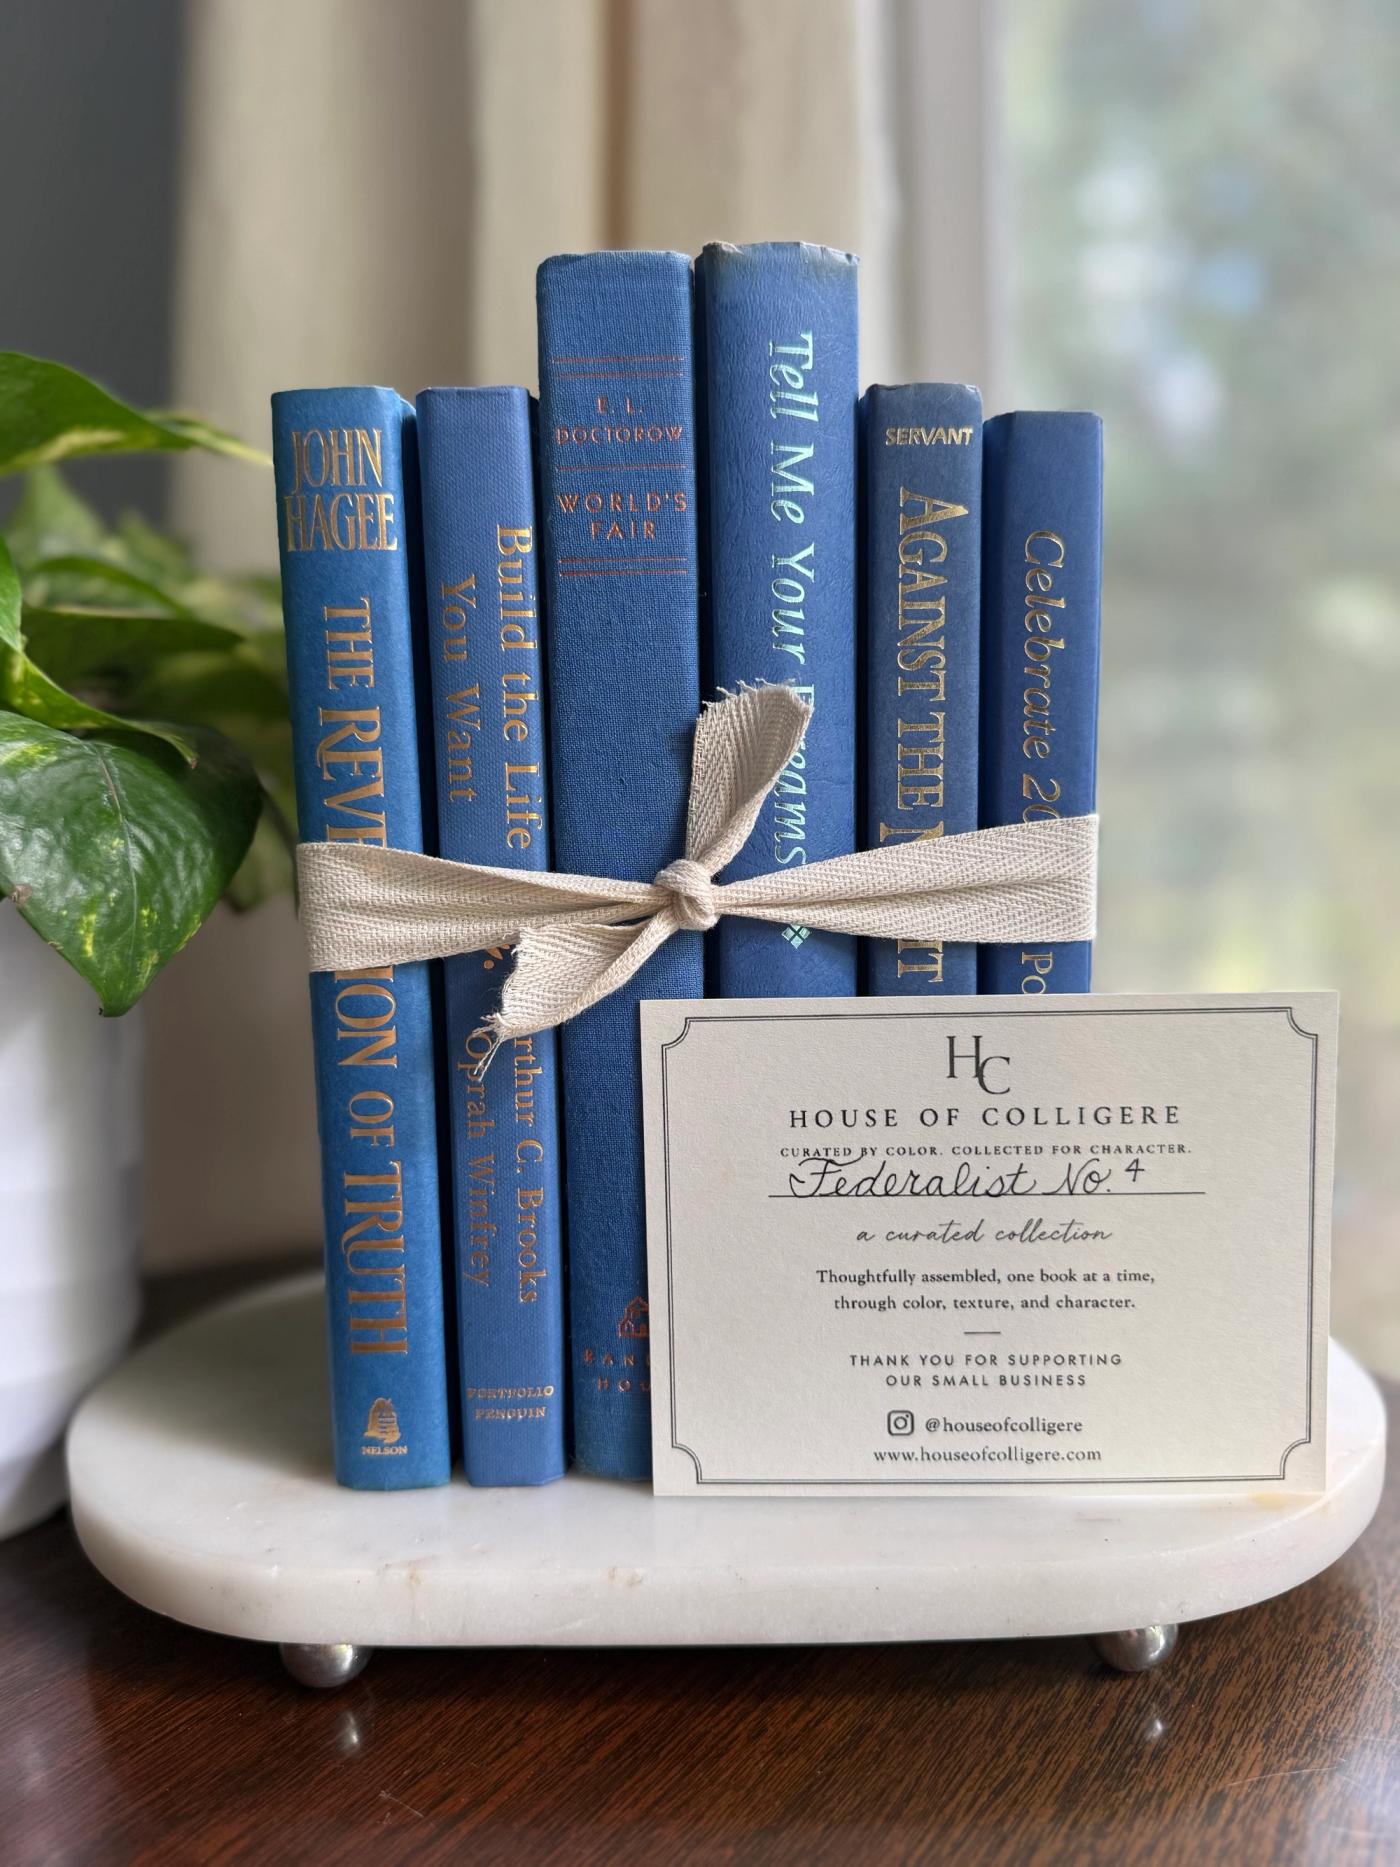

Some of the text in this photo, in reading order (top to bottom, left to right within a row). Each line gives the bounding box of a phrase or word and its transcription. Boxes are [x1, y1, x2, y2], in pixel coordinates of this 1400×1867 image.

[769, 329, 819, 423] Tell
[555, 425, 683, 446] DOCTOROW
[885, 426, 974, 447] SERVANT
[291, 428, 384, 497] JOHN
[770, 442, 815, 524] Me
[556, 491, 688, 514] WORLD'S
[284, 492, 398, 553] HAGEE
[591, 518, 657, 541] FAIR
[771, 542, 815, 665] Your
[897, 486, 970, 702] AGAINST
[323, 595, 375, 691] THE
[1022, 530, 1066, 760] Celebrate
[440, 574, 482, 802] You Want
[496, 524, 543, 850] Build the Life
[897, 711, 946, 811] THE
[348, 1089, 396, 1149] OF
[789, 1105, 1180, 1129] HOUSE OF COLLIGERE
[456, 1030, 498, 1289] Oprah Winfrey
[780, 1143, 1192, 1158] CURATED BY COLOR. COLLECTED FOR CHARACTER.
[513, 1037, 548, 1304] rthur C. Brooks
[789, 1153, 1146, 1198] Federalist No. 4
[856, 1217, 1113, 1245] a curated collection
[341, 1160, 409, 1356] TRUTH
[815, 1267, 1156, 1286] Thoughtfully assembled, one book at a time,
[833, 1294, 1137, 1312] through color, texture, and character.
[849, 1353, 1123, 1367] THANK YOU FOR SUPPORTING
[466, 1385, 554, 1400] PORTFOLIO
[885, 1374, 1087, 1387] OUR SMALL BUSINESS
[475, 1405, 547, 1421] PENGUIN
[924, 1415, 1083, 1436] @houseofcolligere
[361, 1445, 408, 1456] NELSON
[873, 1445, 1103, 1465] www.houseofcolligere.com
